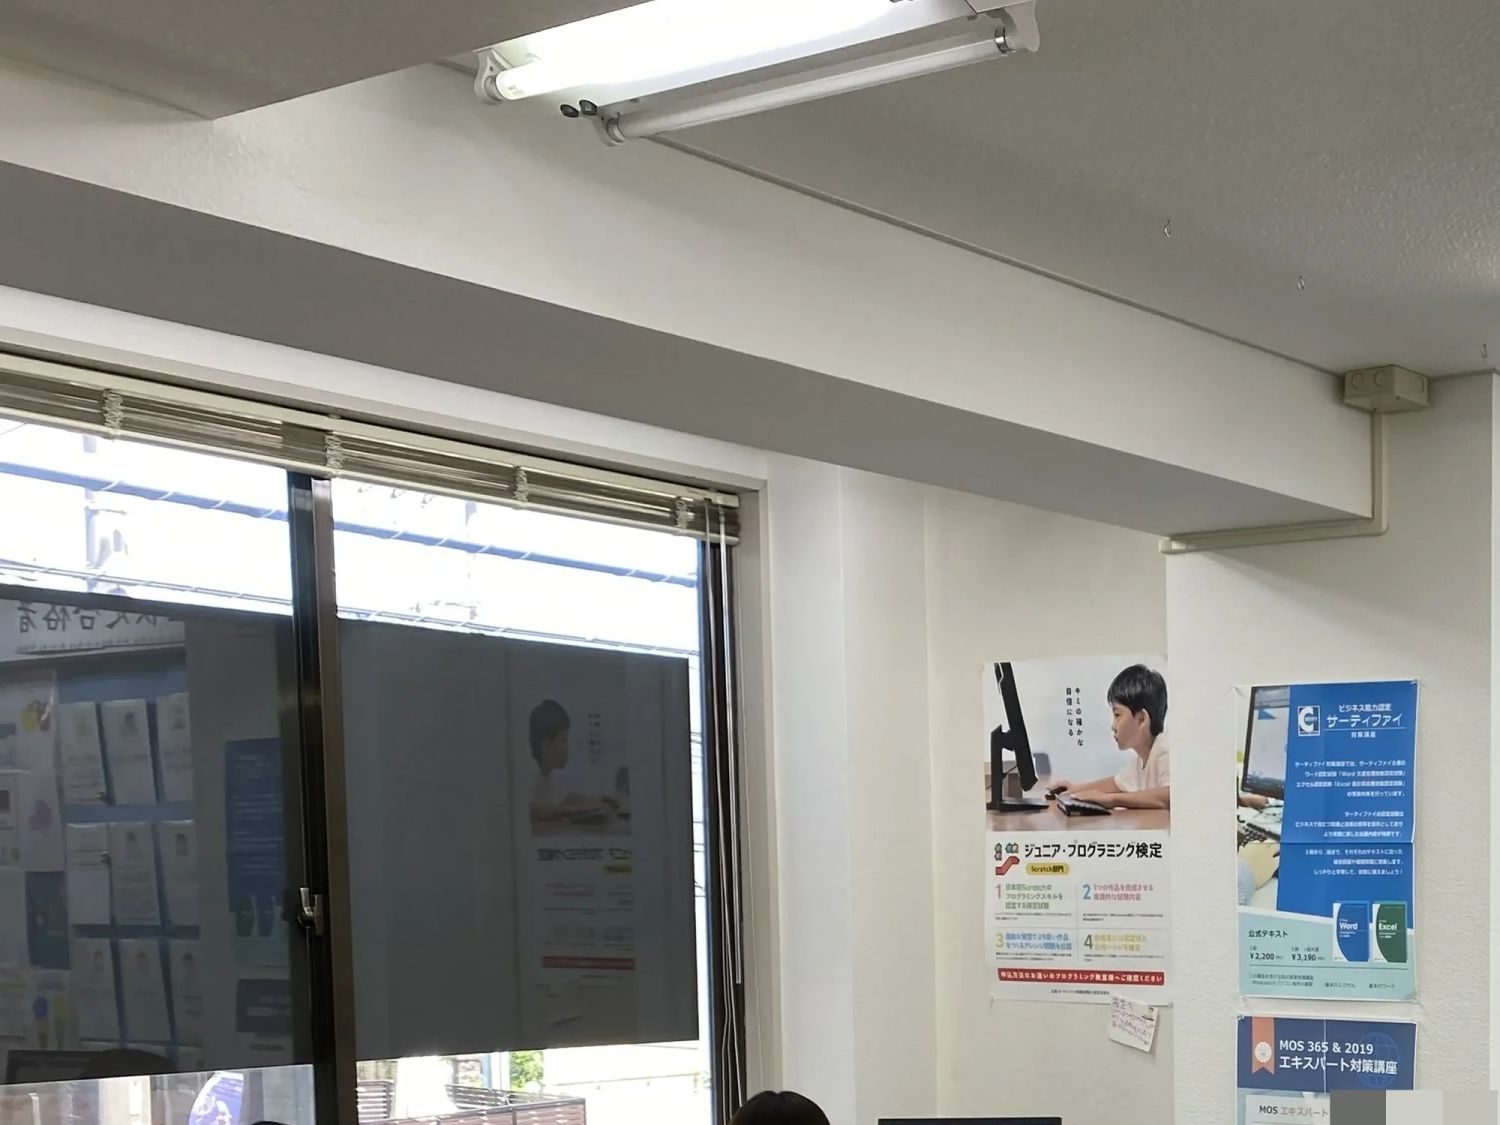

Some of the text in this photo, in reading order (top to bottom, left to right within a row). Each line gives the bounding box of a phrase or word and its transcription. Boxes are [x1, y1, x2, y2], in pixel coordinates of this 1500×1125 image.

[1339, 703, 1392, 712] ビジネス能力認定
[1327, 713, 1403, 728] サーティファイ
[1024, 841, 1163, 859] ジュニア・プログラミング検定
[1339, 922, 1358, 930] Word
[1378, 923, 1397, 931] Excel
[1248, 930, 1288, 938] 公式テキスト
[1084, 935, 1093, 949] 4
[1280, 1040, 1373, 1055] MOS 365 & 2019
[1279, 1056, 1398, 1075] エキスパート対策講座
[1259, 1105, 1328, 1117] MOS エキスパート
